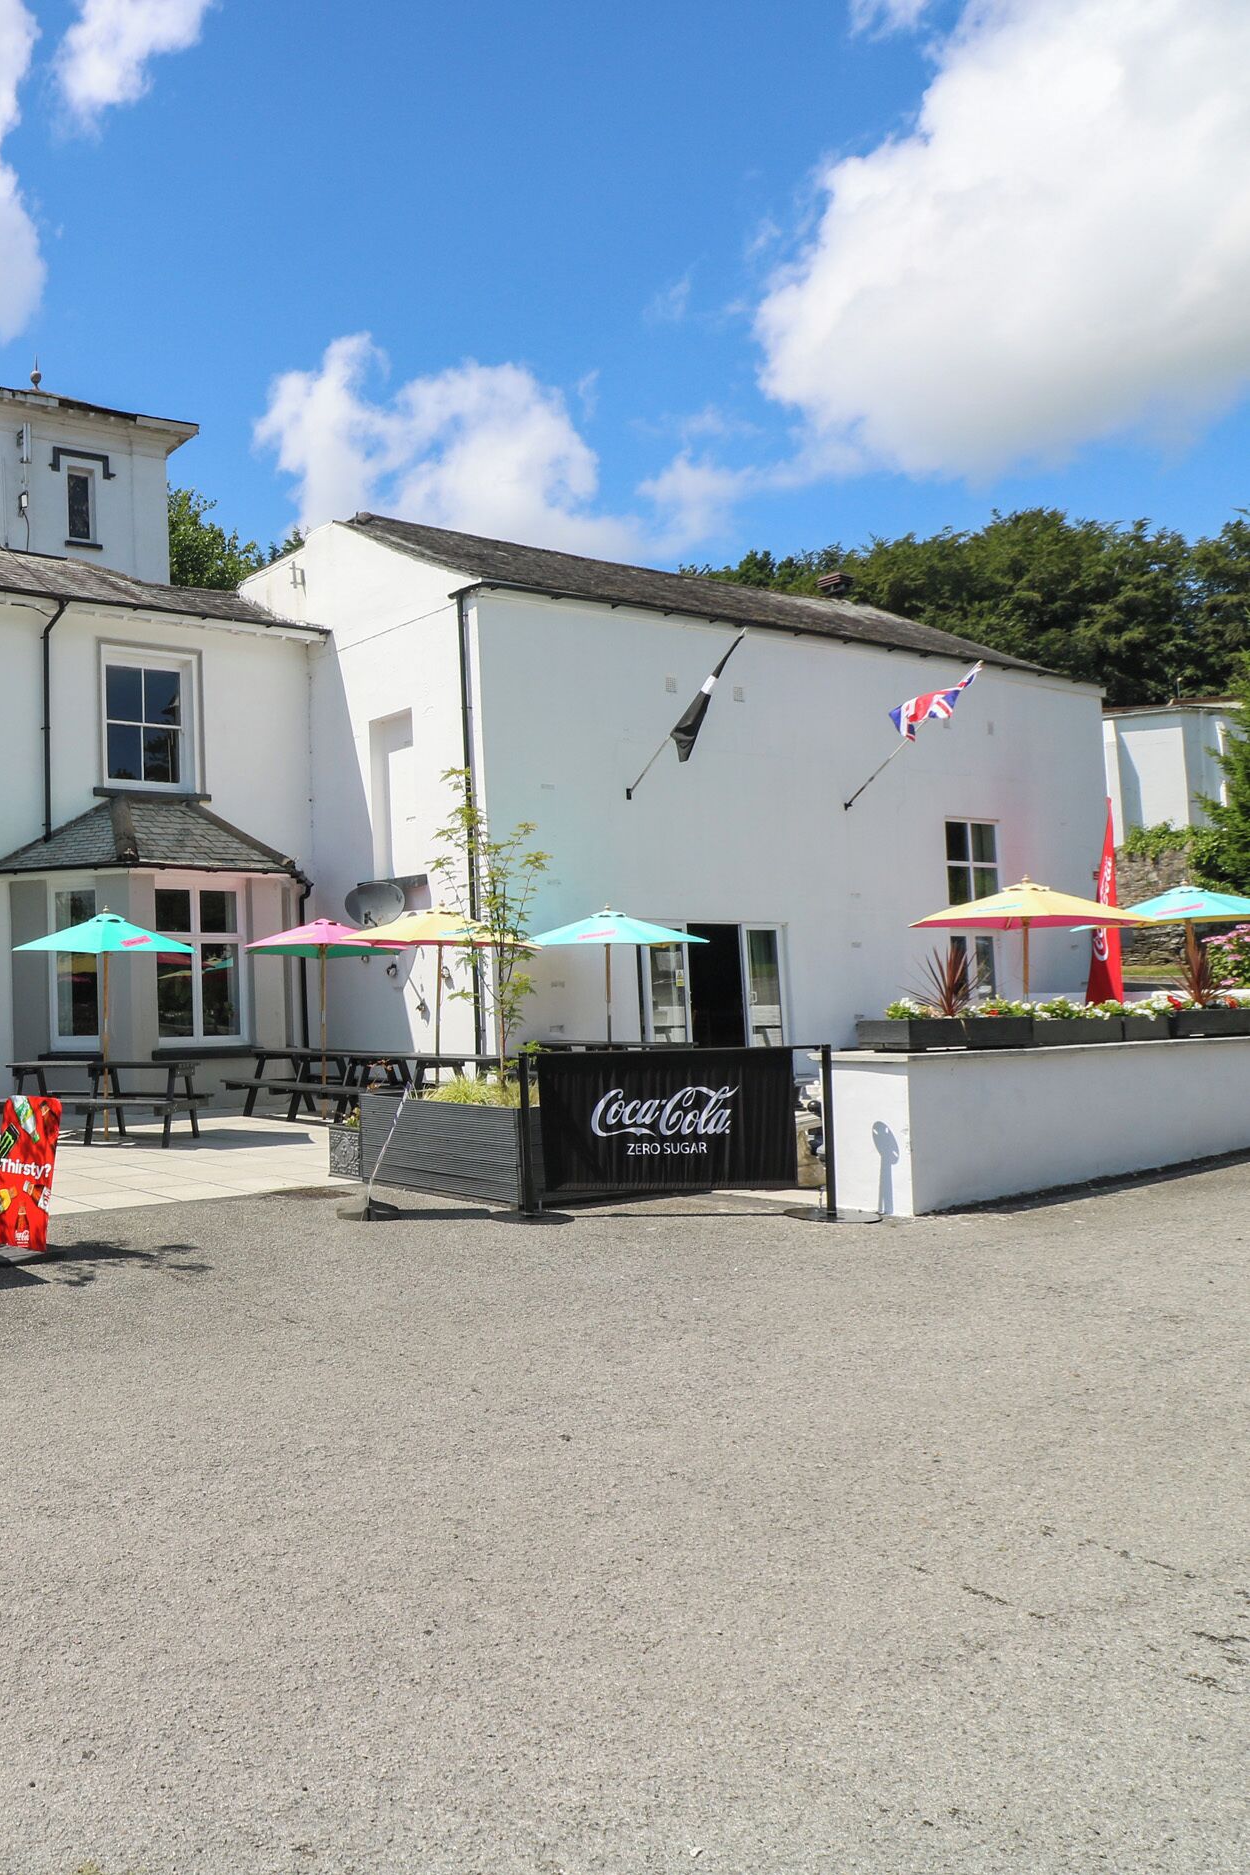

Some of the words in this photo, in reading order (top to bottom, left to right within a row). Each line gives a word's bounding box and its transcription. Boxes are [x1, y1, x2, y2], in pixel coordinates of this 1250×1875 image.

[591, 1085, 739, 1137] Coca-Cola
[626, 1142, 660, 1156] ZERO
[663, 1141, 707, 1155] SUGAR
[0, 1158, 52, 1179] Thirsty?
